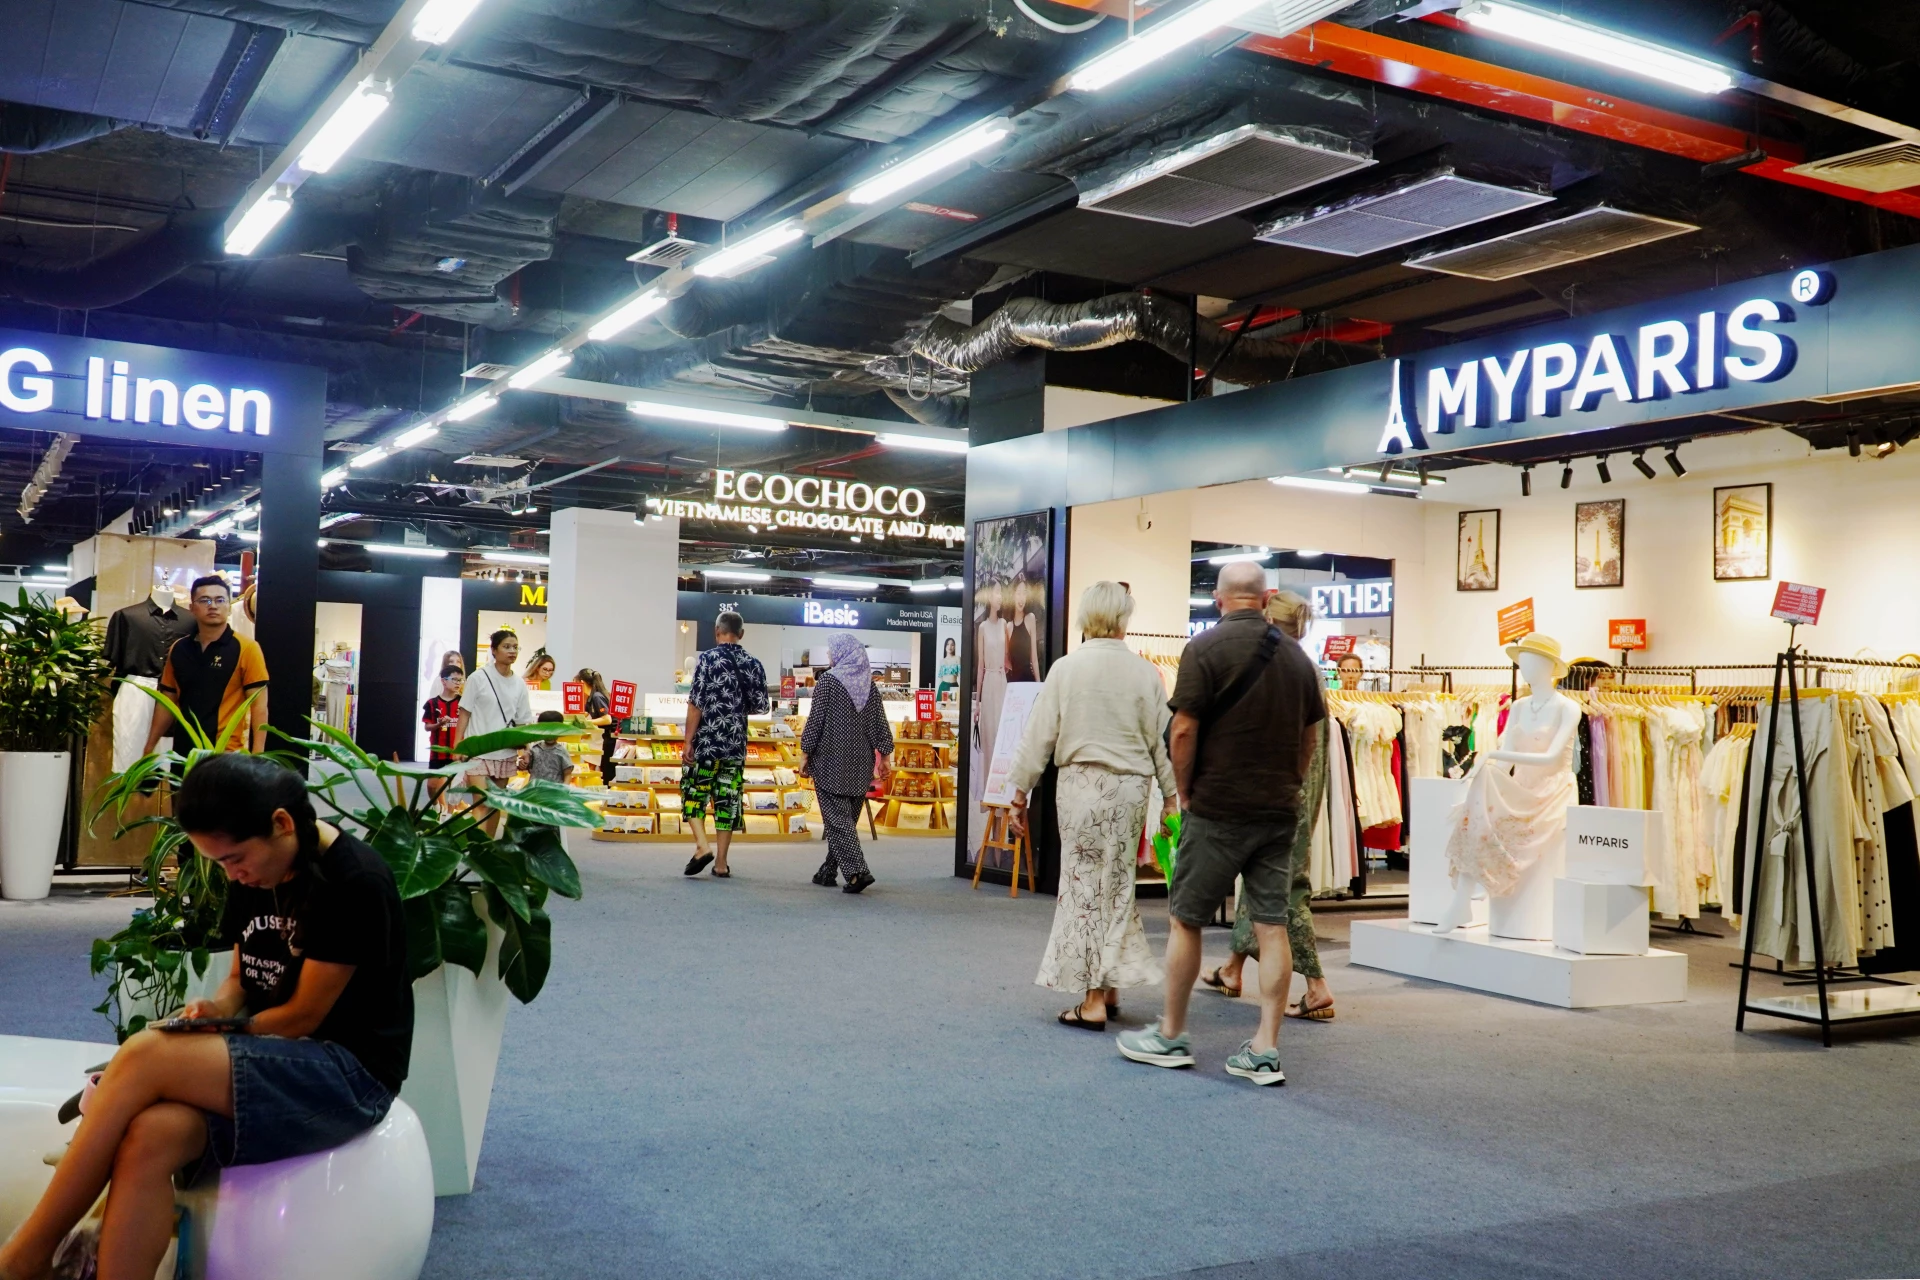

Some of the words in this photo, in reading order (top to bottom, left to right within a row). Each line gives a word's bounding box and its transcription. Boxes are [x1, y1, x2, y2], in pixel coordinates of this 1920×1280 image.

[1427, 298, 1783, 433] MYPARIS
[0, 347, 54, 413] G
[86, 356, 271, 436] linen
[714, 468, 926, 517] ECOCHOCO
[655, 499, 772, 524] VIETNAMESE
[775, 509, 884, 535] CHOCOLATE
[887, 520, 926, 538] AND
[520, 585, 548, 606] M
[803, 602, 859, 626] iBasic
[920, 611, 934, 619] USA
[887, 618, 903, 626] Made
[908, 620, 933, 628] Vietnam
[940, 615, 963, 625] iBasic
[1619, 625, 1635, 635] NEW
[1611, 635, 1644, 645] ARRIVAL
[615, 684, 627, 694] BUY
[627, 686, 633, 694] 5
[567, 694, 577, 702] GET
[615, 695, 626, 703] GET
[615, 705, 628, 714] FREE
[1578, 834, 1629, 850] MYPARIS
